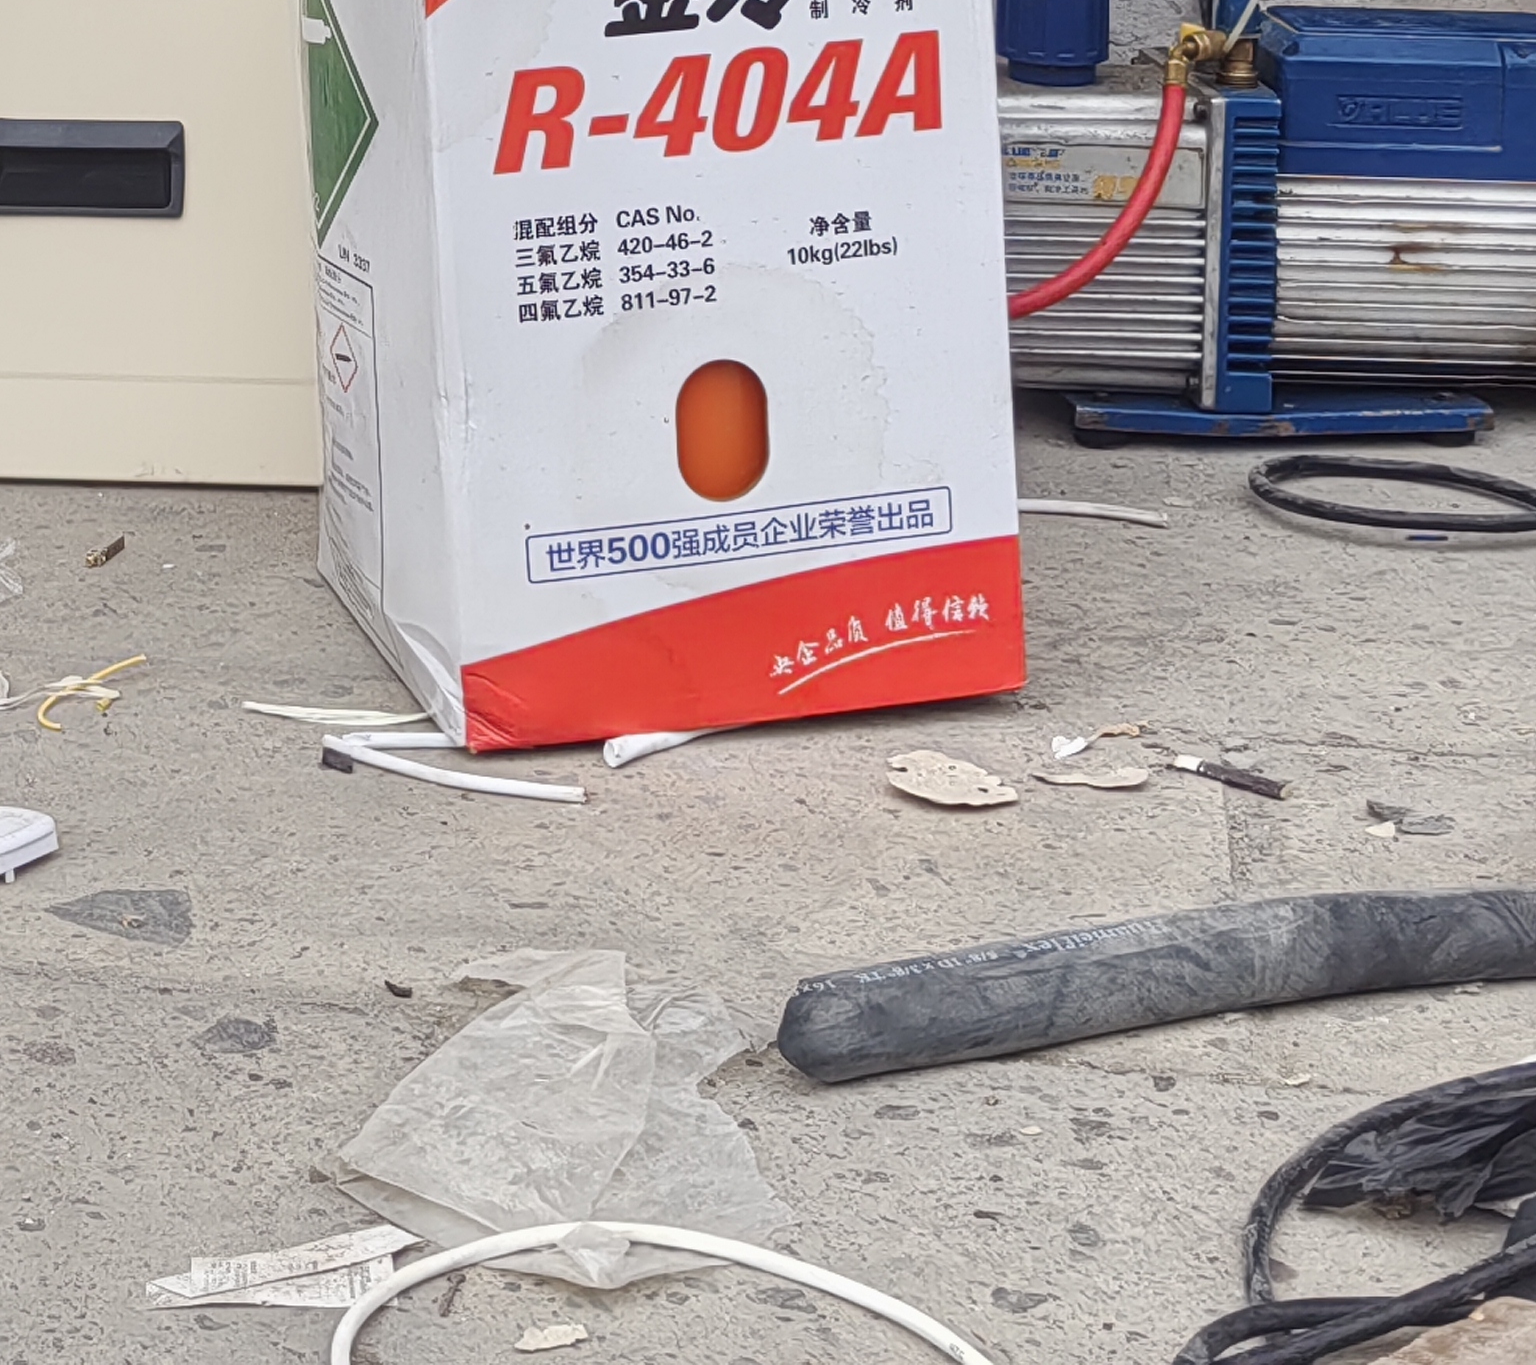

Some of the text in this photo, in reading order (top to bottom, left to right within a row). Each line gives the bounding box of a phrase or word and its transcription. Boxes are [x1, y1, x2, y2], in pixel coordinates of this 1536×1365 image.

[493, 30, 942, 174] R-404A
[513, 204, 701, 241] 混配组分 CAS No.
[809, 210, 872, 237] 净含量
[515, 230, 713, 268] 三氟乙烷 420-46-2
[787, 235, 898, 265] 10kg(22lbs)
[517, 257, 715, 296] 五氟乙烷 354-33-6
[519, 285, 717, 323] 四氟乙烷 811-97-2
[546, 498, 934, 572] 世界500强成员企业荣誉出品
